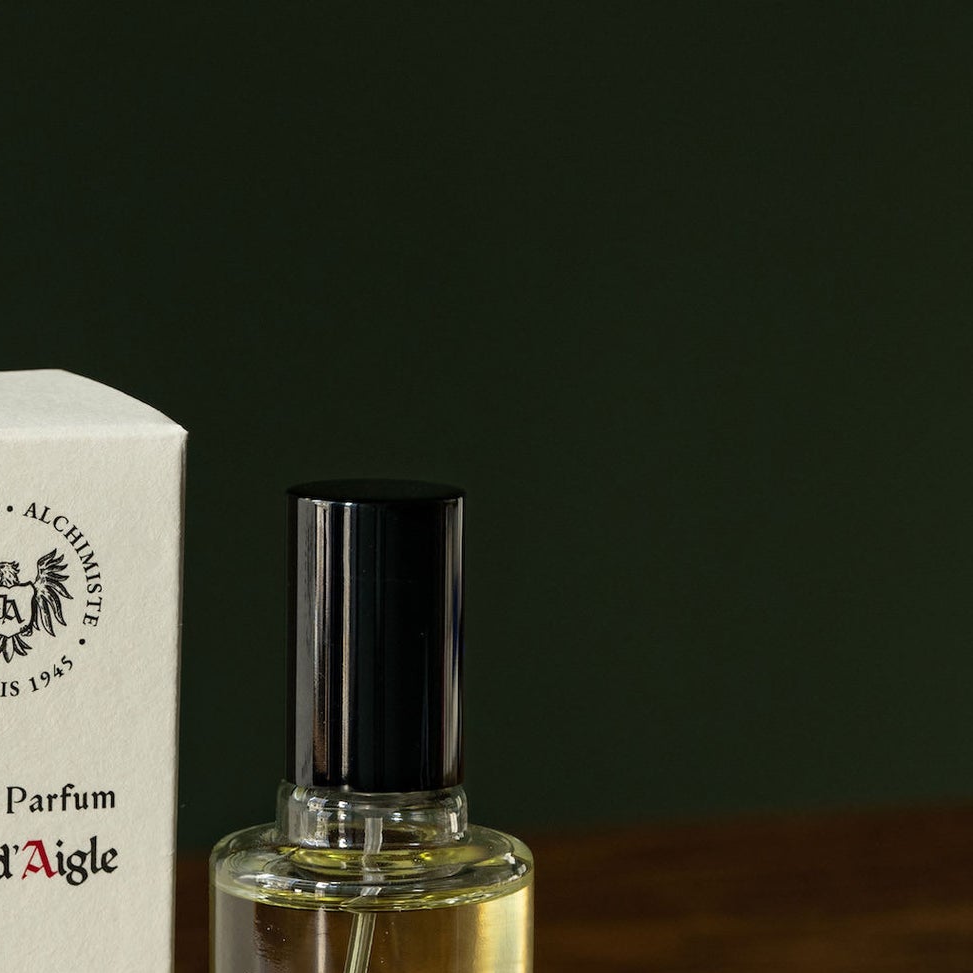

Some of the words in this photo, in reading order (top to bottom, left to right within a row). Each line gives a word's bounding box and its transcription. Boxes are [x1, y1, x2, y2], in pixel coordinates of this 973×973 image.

[23, 502, 103, 627] ALCHIMISTE
[30, 655, 74, 693] 1945
[6, 783, 116, 814] Parfum
